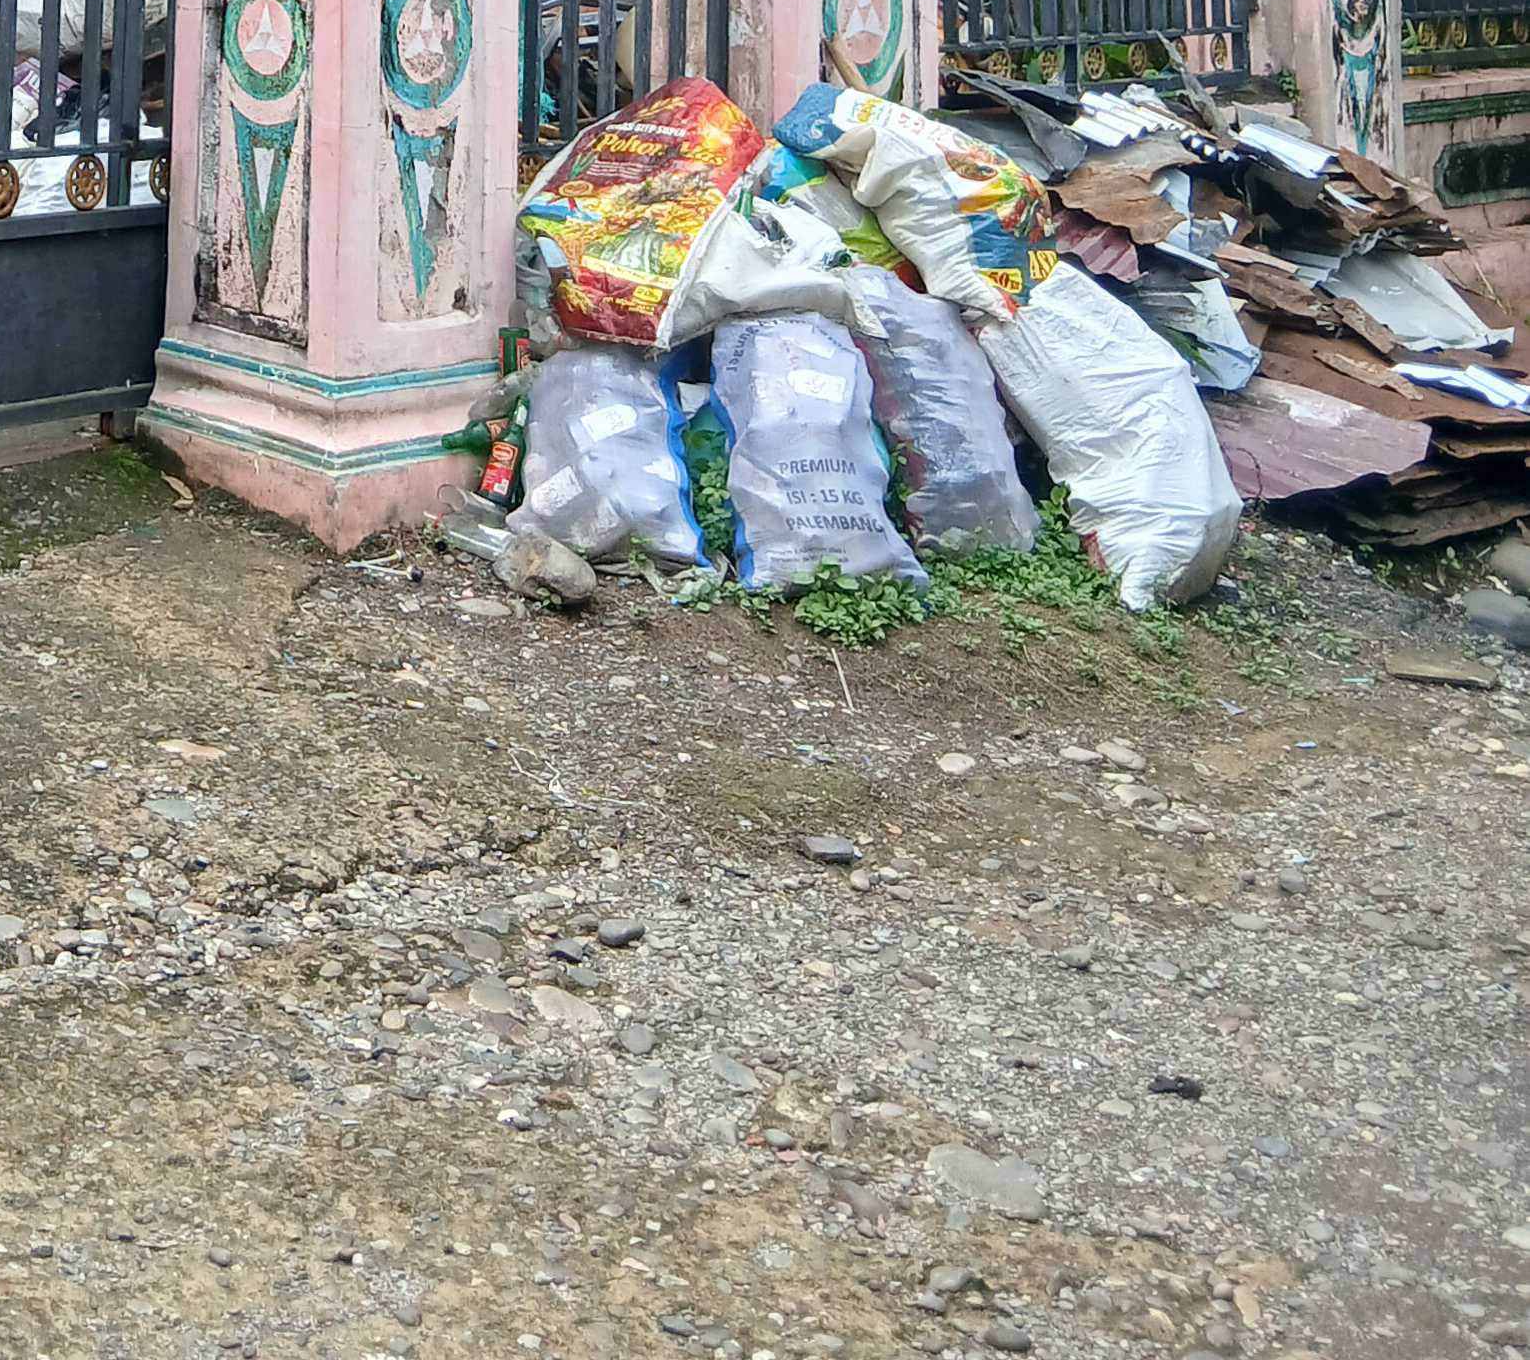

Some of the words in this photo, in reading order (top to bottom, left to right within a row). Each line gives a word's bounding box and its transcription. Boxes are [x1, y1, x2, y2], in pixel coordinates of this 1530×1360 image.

[778, 458, 857, 476] PREMIUM
[786, 489, 807, 505] ISI
[819, 488, 839, 503] 15
[841, 489, 866, 506] KG
[785, 515, 885, 533] PALEMBANG
